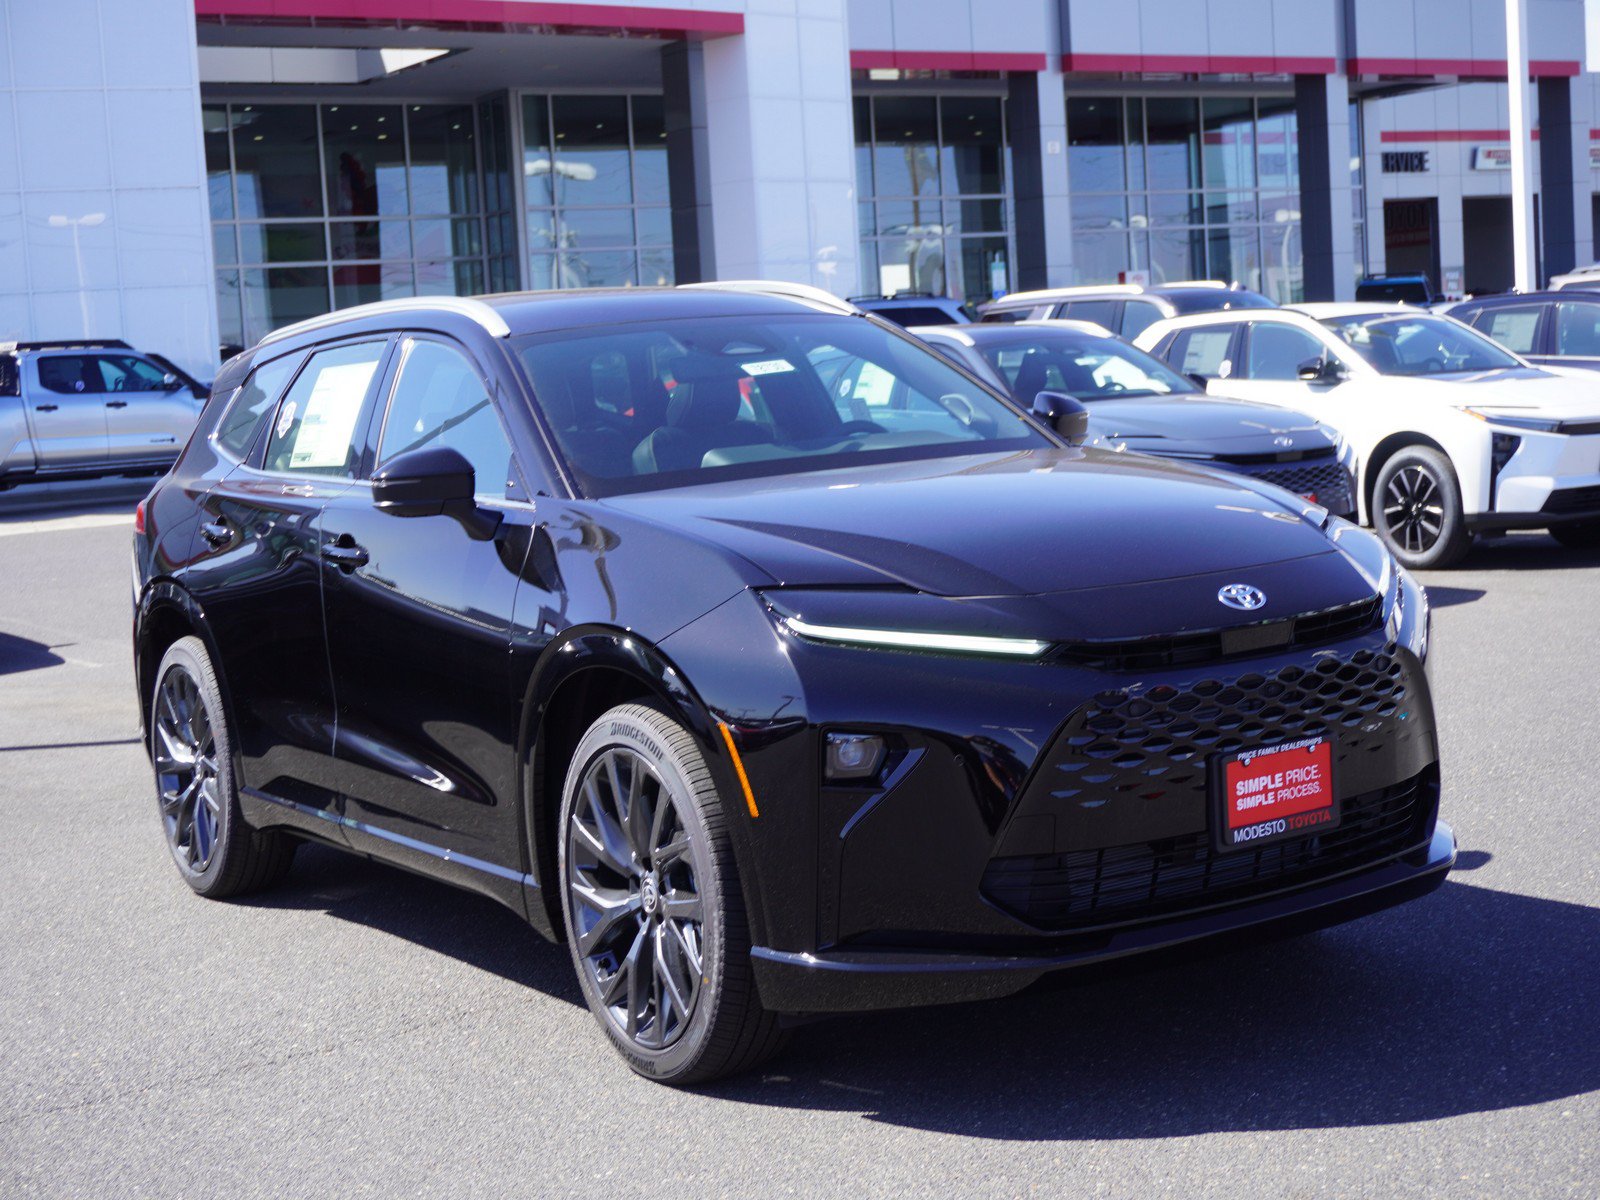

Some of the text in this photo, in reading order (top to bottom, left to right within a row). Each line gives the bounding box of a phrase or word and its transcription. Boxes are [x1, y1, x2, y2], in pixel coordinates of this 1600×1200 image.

[610, 722, 664, 762] BRIDGESTONE
[1237, 737, 1322, 761] PRICE FAMILY DEALERSHIPS
[1236, 764, 1321, 796] SIMPLE PRICE.
[1236, 781, 1322, 811] SIMPLE PROCESS.
[1234, 809, 1331, 843] MODESTO TOYOTA
